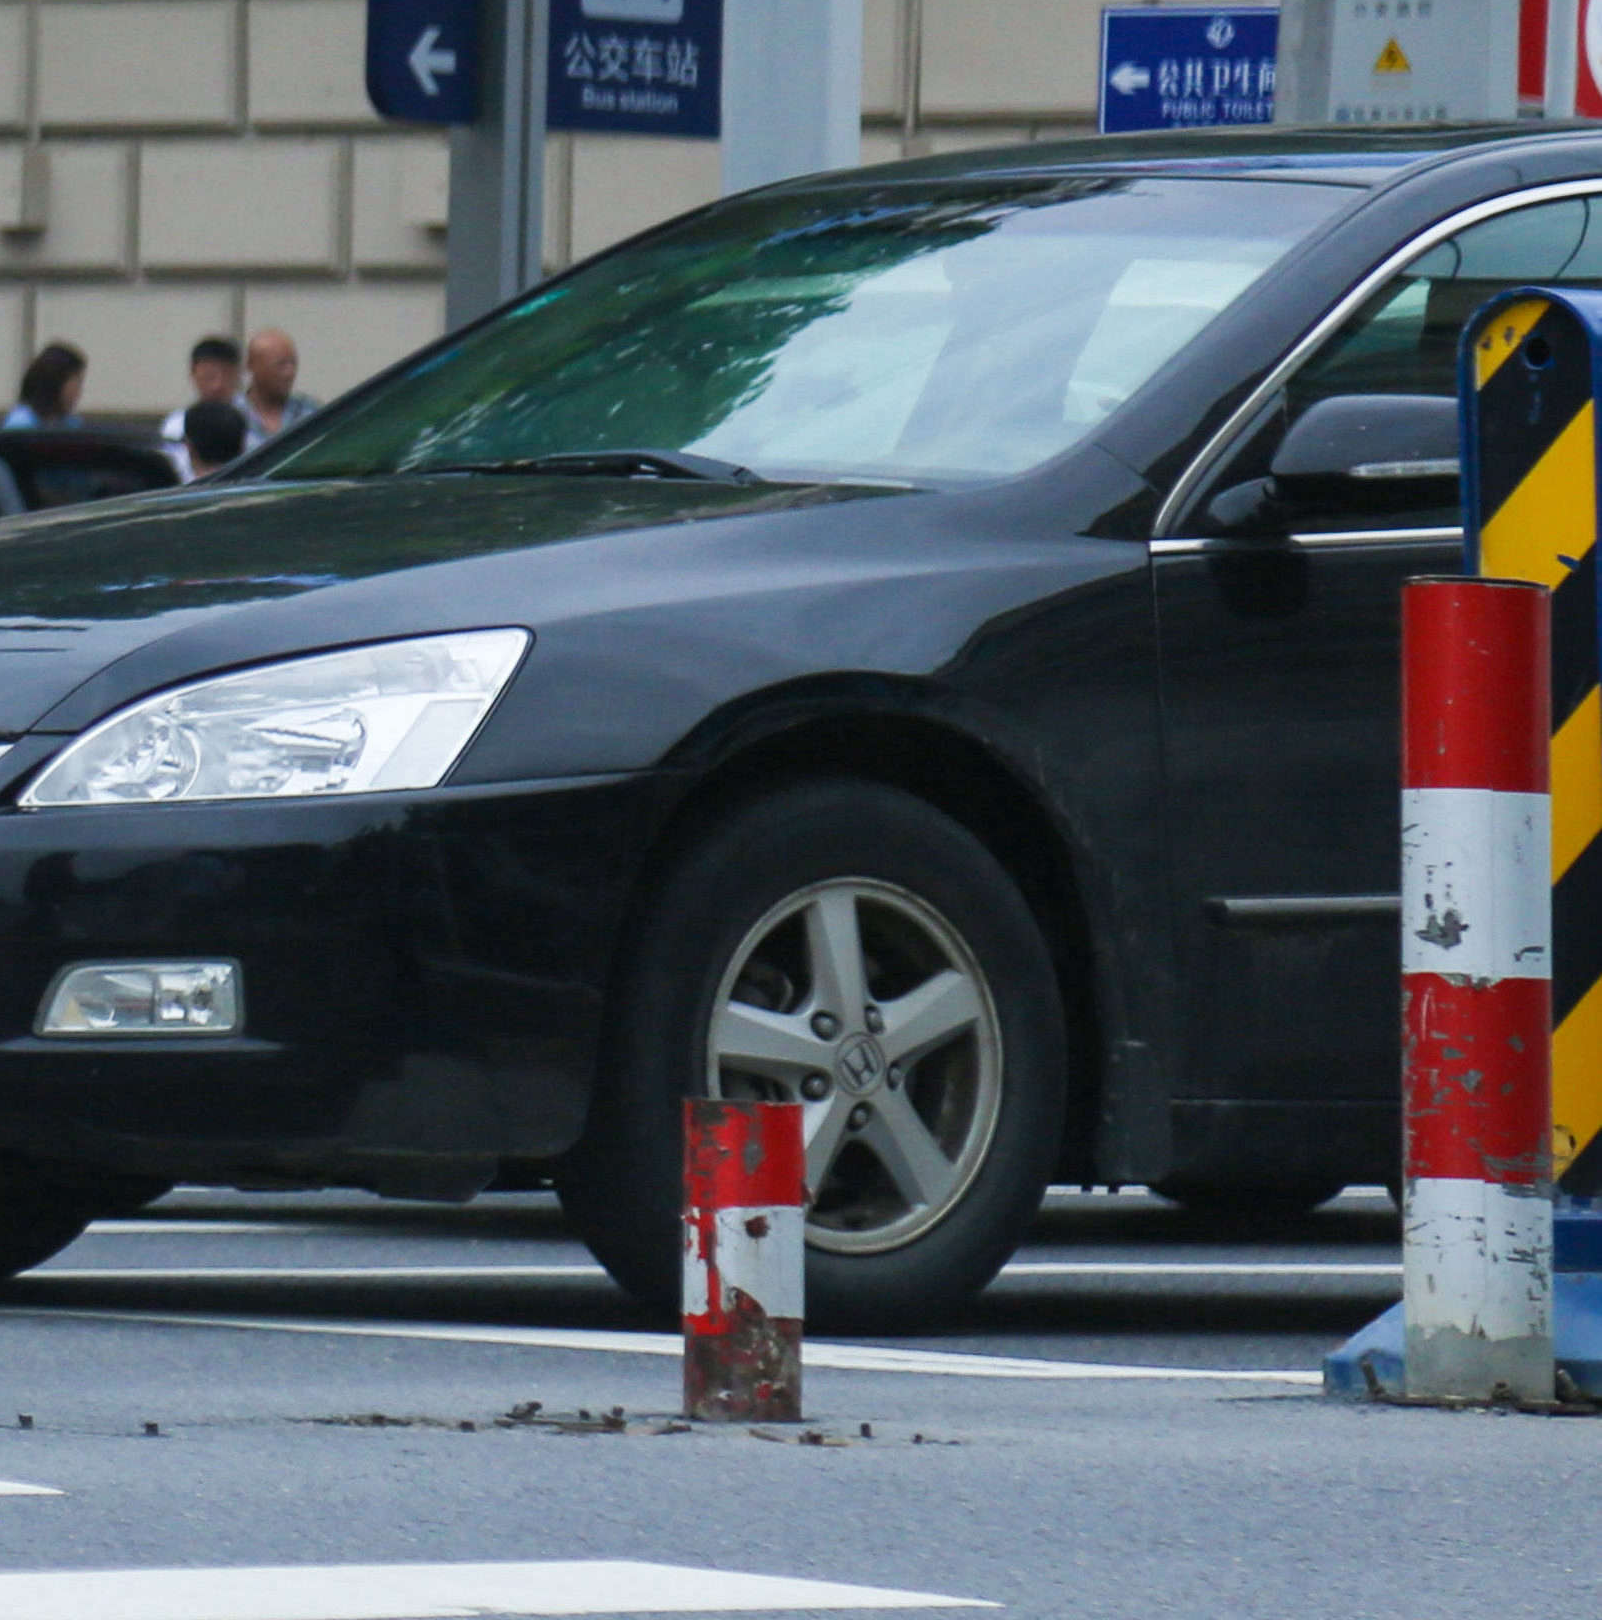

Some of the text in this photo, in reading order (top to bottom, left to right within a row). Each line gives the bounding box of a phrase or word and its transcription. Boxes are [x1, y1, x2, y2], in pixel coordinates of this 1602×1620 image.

[564, 32, 700, 87] 公交车站
[1158, 58, 1277, 98] 公共卫生间
[581, 86, 680, 116] Bus station
[1162, 101, 1215, 119] PUBLIC
